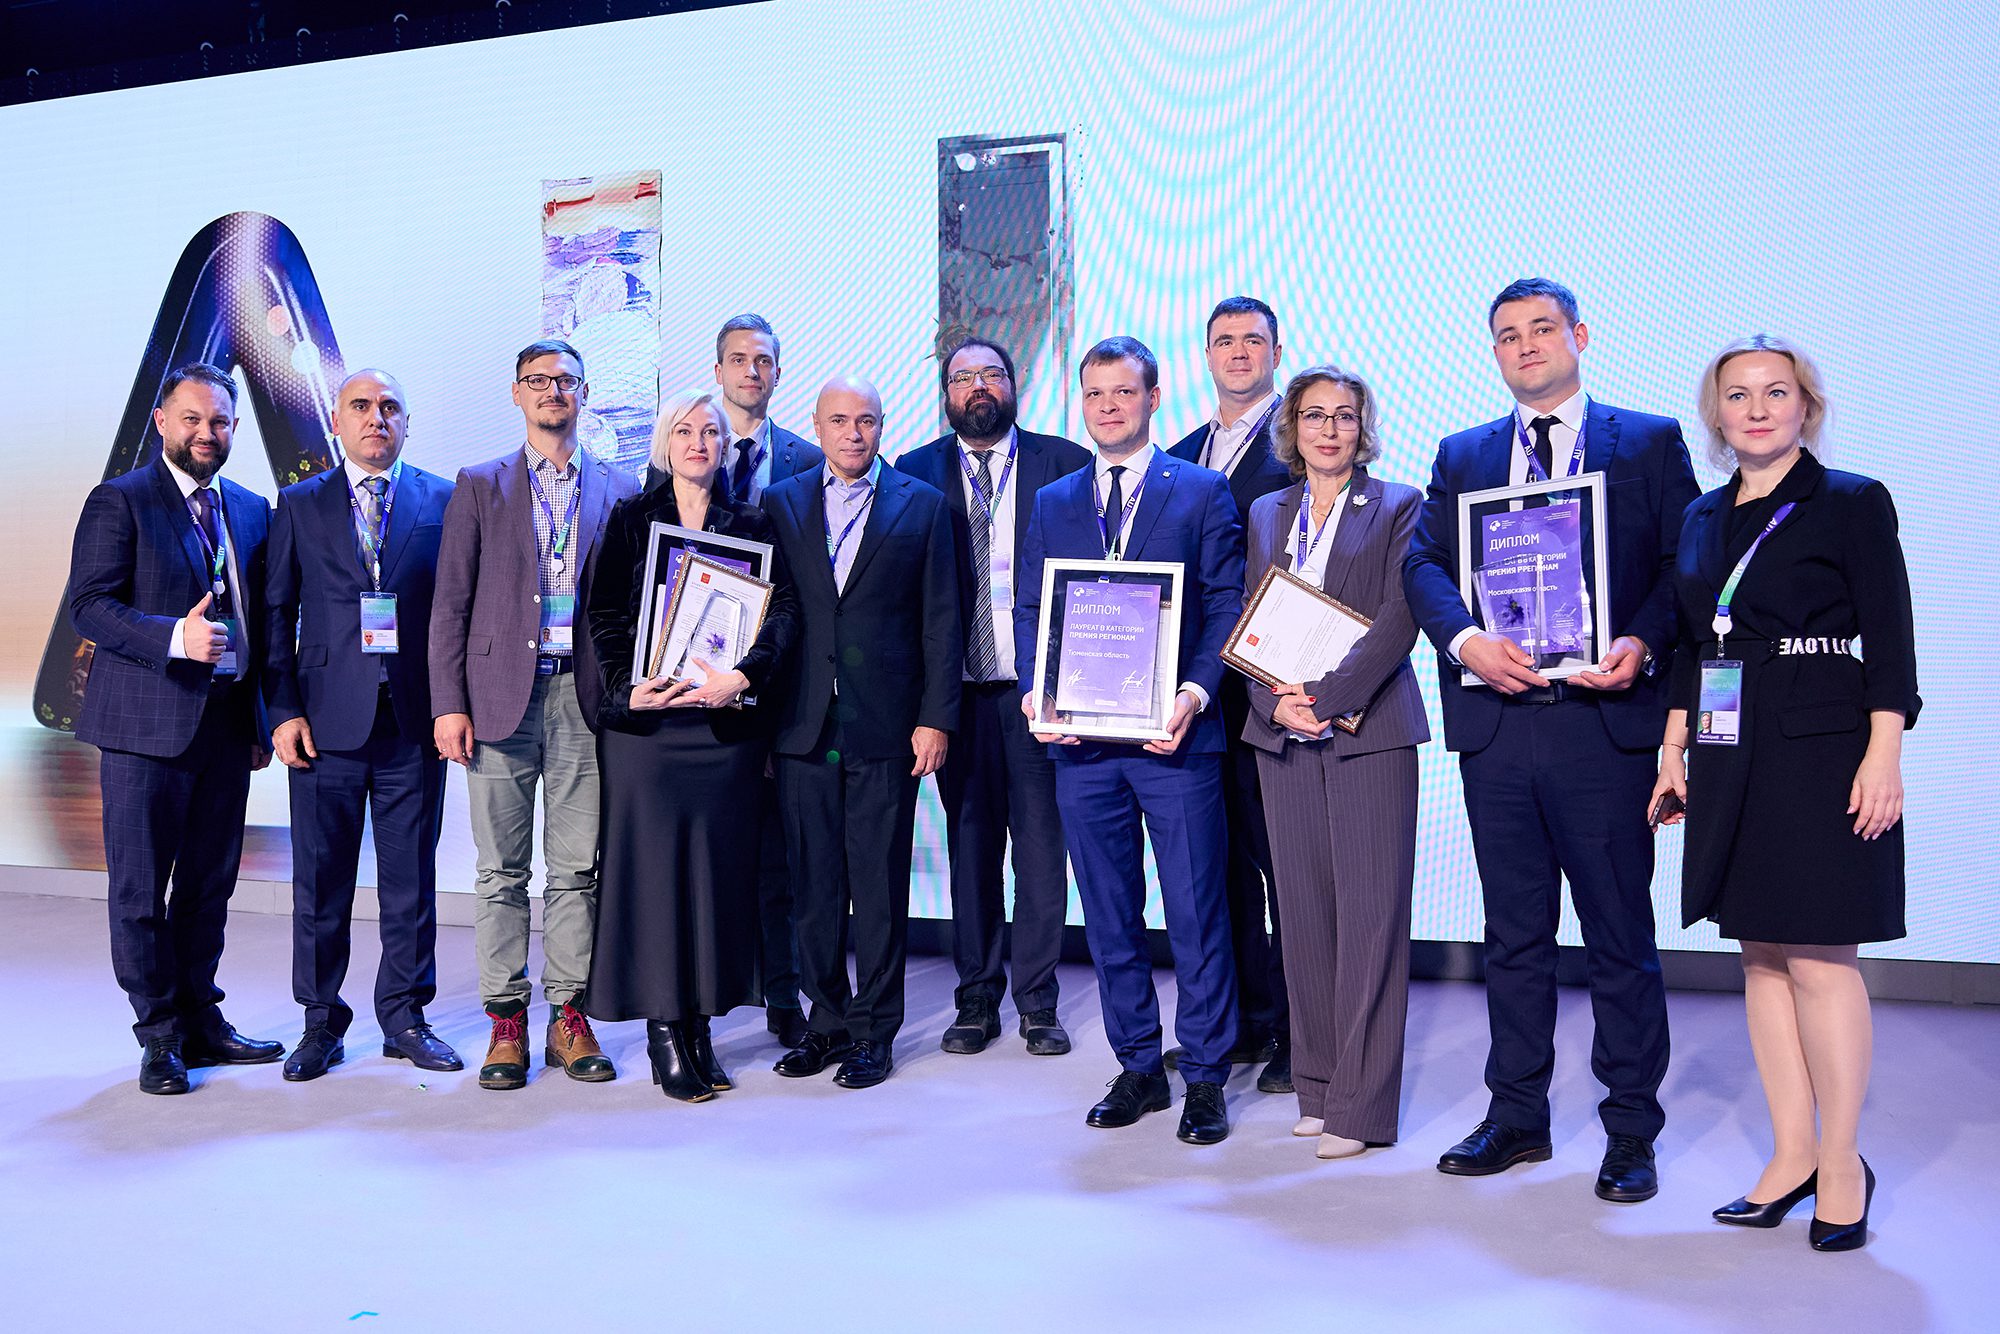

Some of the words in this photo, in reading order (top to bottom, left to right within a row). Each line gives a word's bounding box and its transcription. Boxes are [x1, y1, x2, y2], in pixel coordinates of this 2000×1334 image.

[1489, 533, 1540, 552] ДИПЛОМ
[1487, 567, 1516, 577] ПРЕМИЯ
[1071, 603, 1121, 615] ДИПЛОМ
[1070, 623, 1100, 631] ЛАУРЕАТ
[1105, 625, 1145, 633] КАТЕГОРИИ
[1069, 631, 1098, 639] ПРЕМИЯ
[1099, 633, 1136, 641] РЕГИОНАМ
